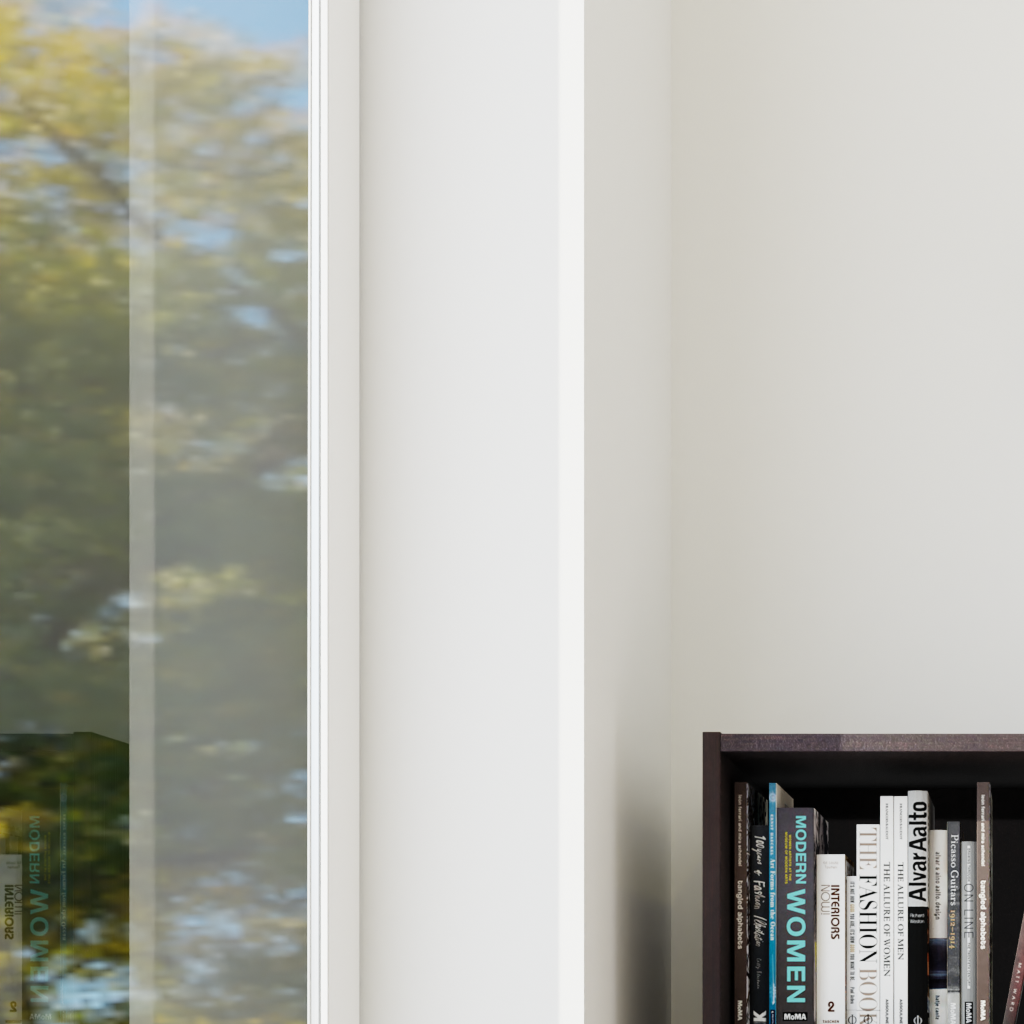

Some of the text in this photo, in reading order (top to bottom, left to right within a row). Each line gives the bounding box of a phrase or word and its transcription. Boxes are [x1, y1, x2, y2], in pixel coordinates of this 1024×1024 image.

[859, 827, 878, 870] THE
[950, 834, 959, 868] Picasso
[786, 815, 807, 1003] MODERN WOMEN
[830, 884, 840, 939] INTERIORS
[950, 869, 959, 906] Guitars
[859, 875, 878, 963] FASHION
[978, 880, 987, 950] tangled alphabets
[1009, 962, 1023, 1012] MATT WARD
[783, 1013, 807, 1021] MoMA
